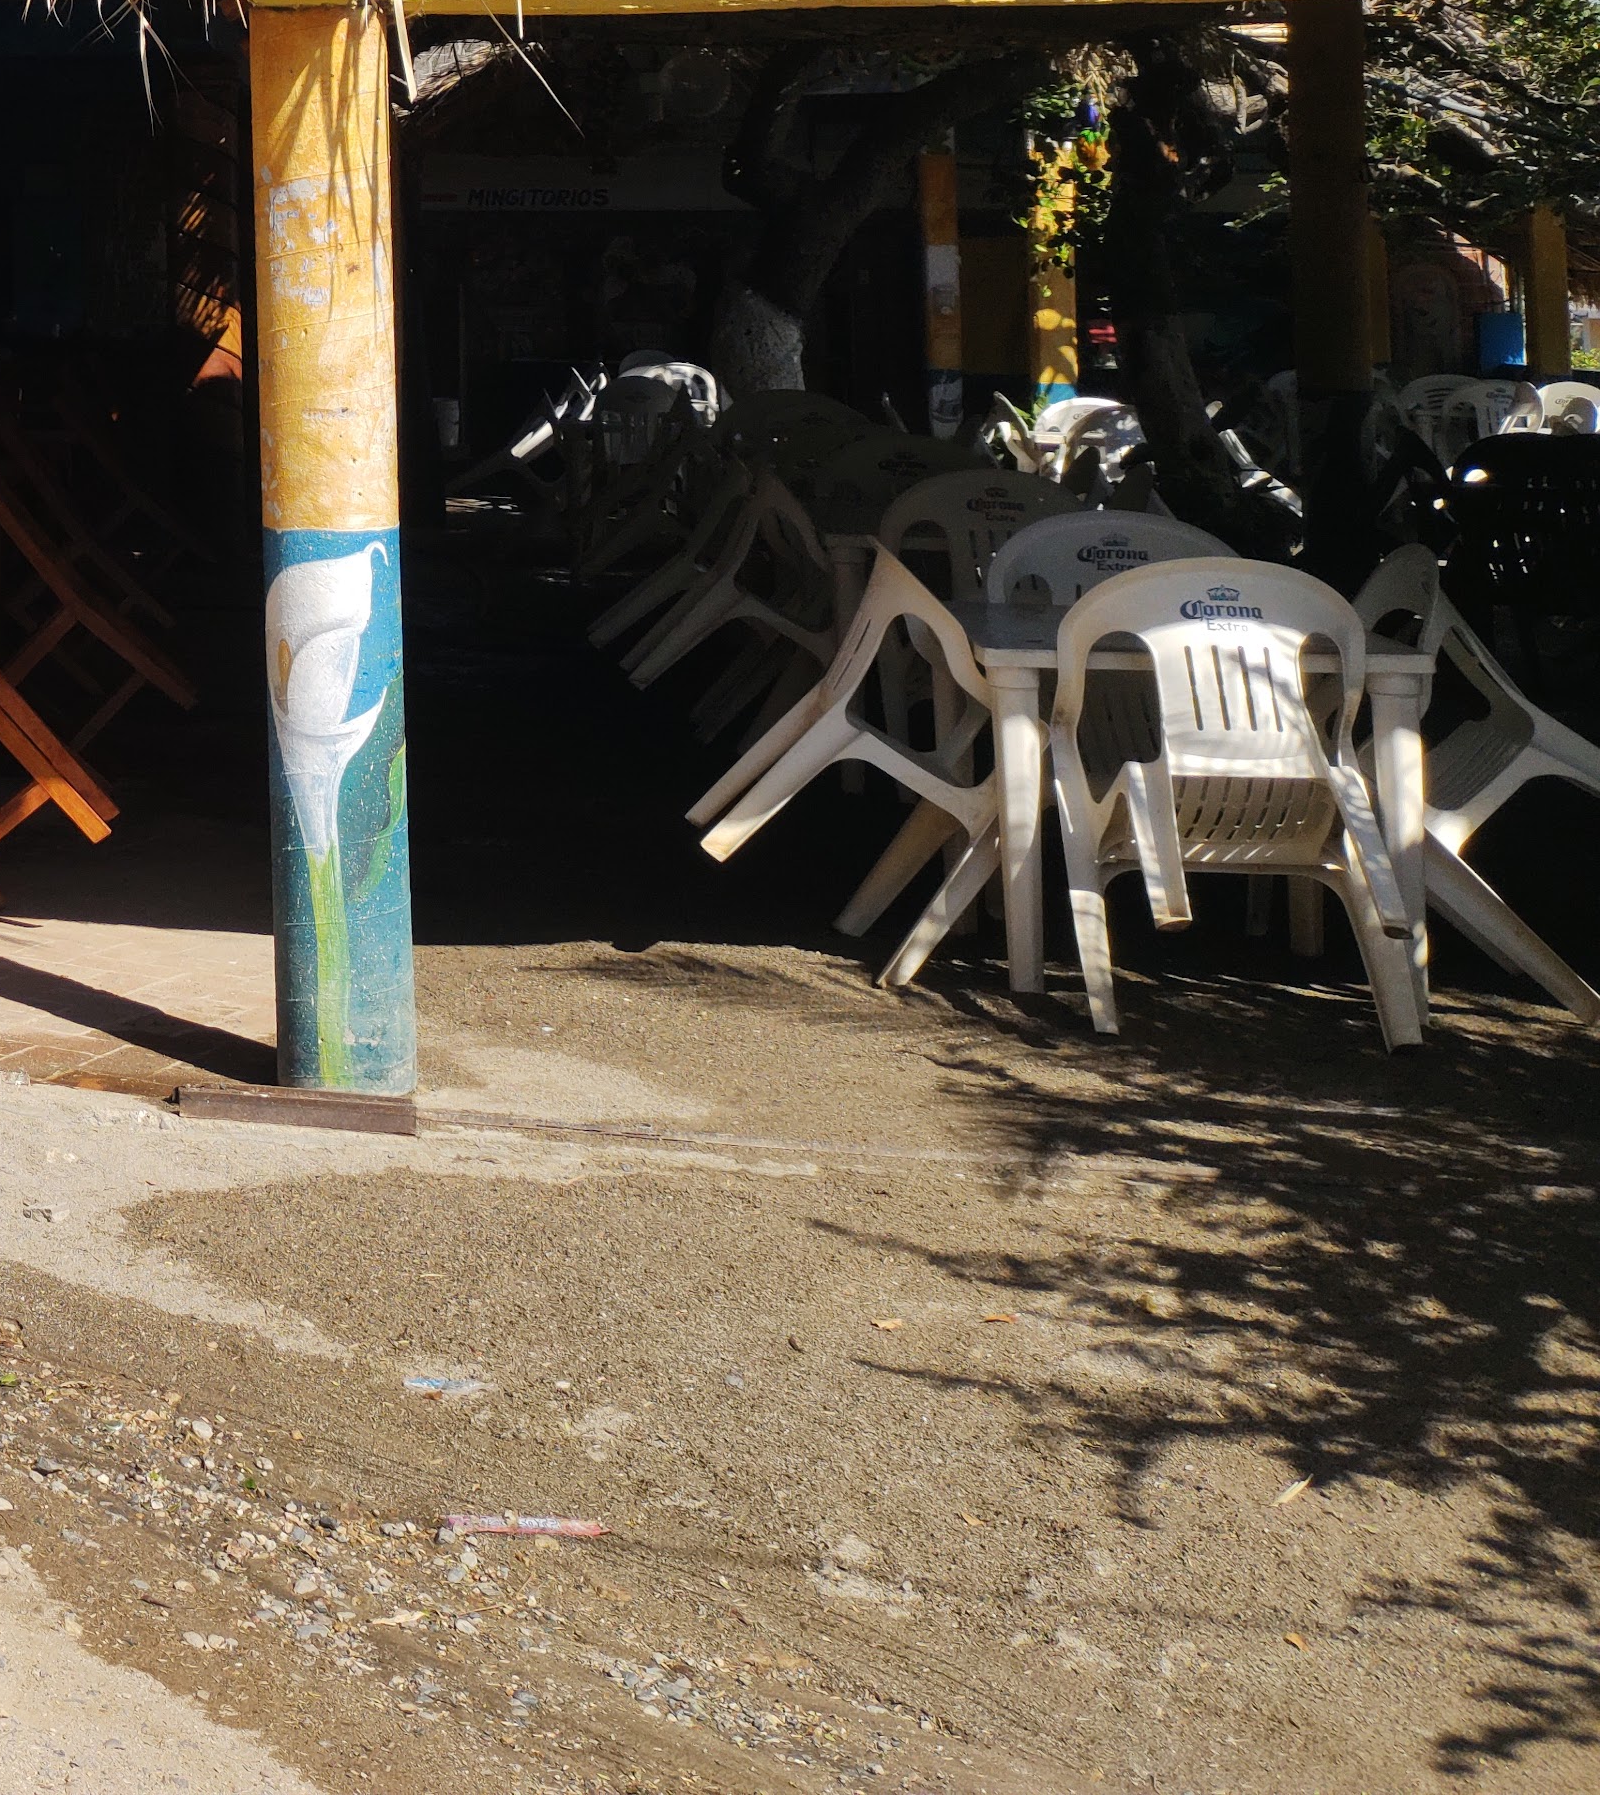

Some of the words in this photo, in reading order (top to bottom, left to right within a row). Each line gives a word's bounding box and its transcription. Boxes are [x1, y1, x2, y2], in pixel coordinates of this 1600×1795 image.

[467, 188, 609, 206] MINGITORIOS
[1077, 545, 1149, 563] Corona
[1179, 599, 1264, 621] Corona
[1206, 618, 1249, 632] Extra
